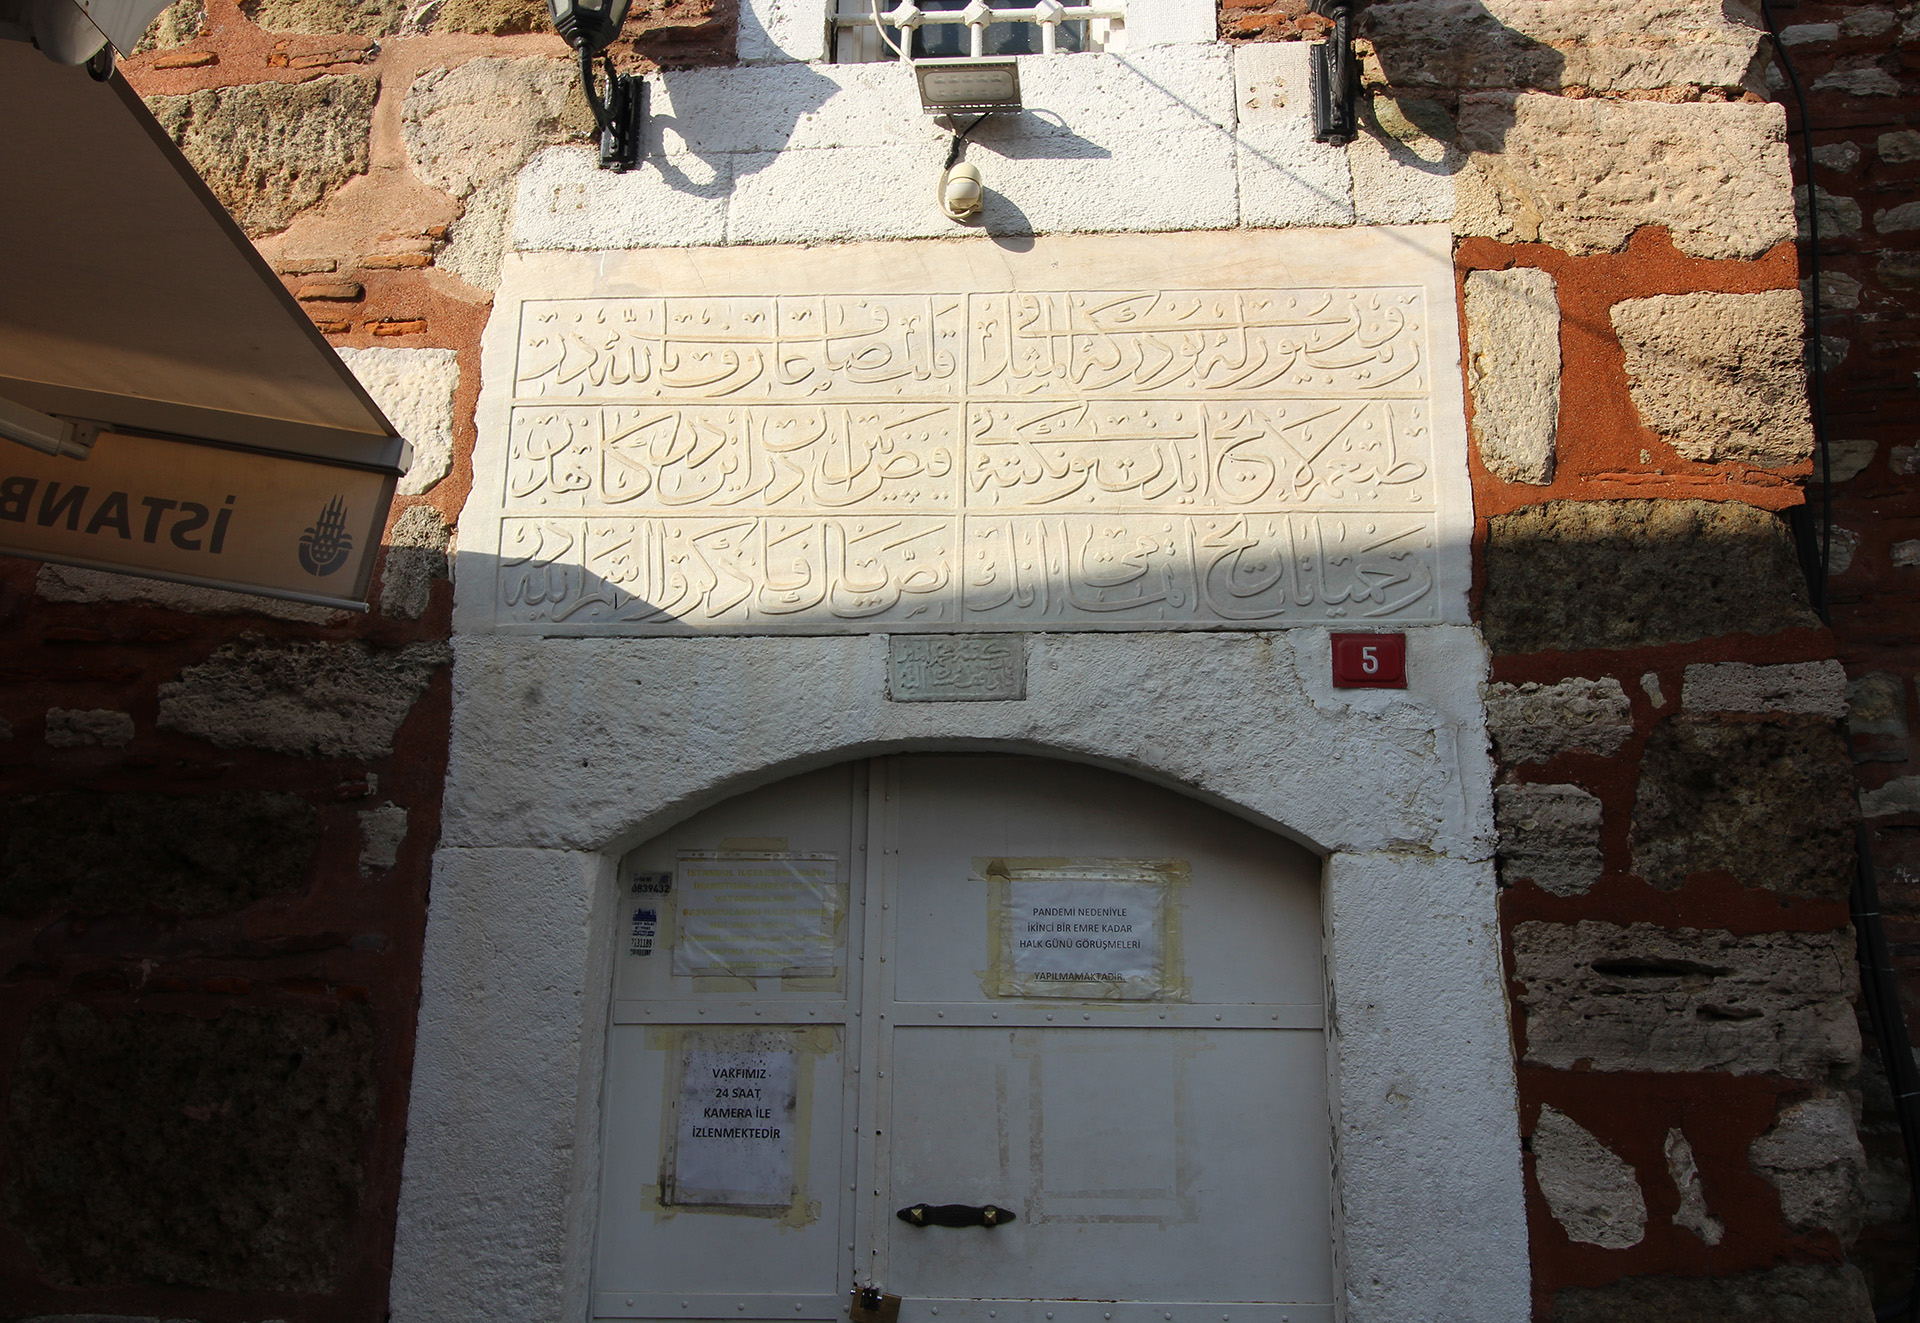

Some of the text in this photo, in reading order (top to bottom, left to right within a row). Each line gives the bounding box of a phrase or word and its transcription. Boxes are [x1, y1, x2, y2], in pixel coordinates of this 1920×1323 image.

[1362, 646, 1379, 674] 5
[1032, 906, 1127, 917] PANDEMİ NEDENİYLE
[1027, 922, 1133, 933] İKİNCİ BİR EMRE KADAR
[1019, 939, 1141, 951] HALK GÜNÜ GÖRÜŞMELERİ
[712, 1068, 768, 1080] VAKFIMIZ
[715, 1087, 762, 1099] 24 SAAT
[703, 1106, 772, 1119] KAMERA İLE
[692, 1125, 781, 1139] İZLENMEKTEDİR
